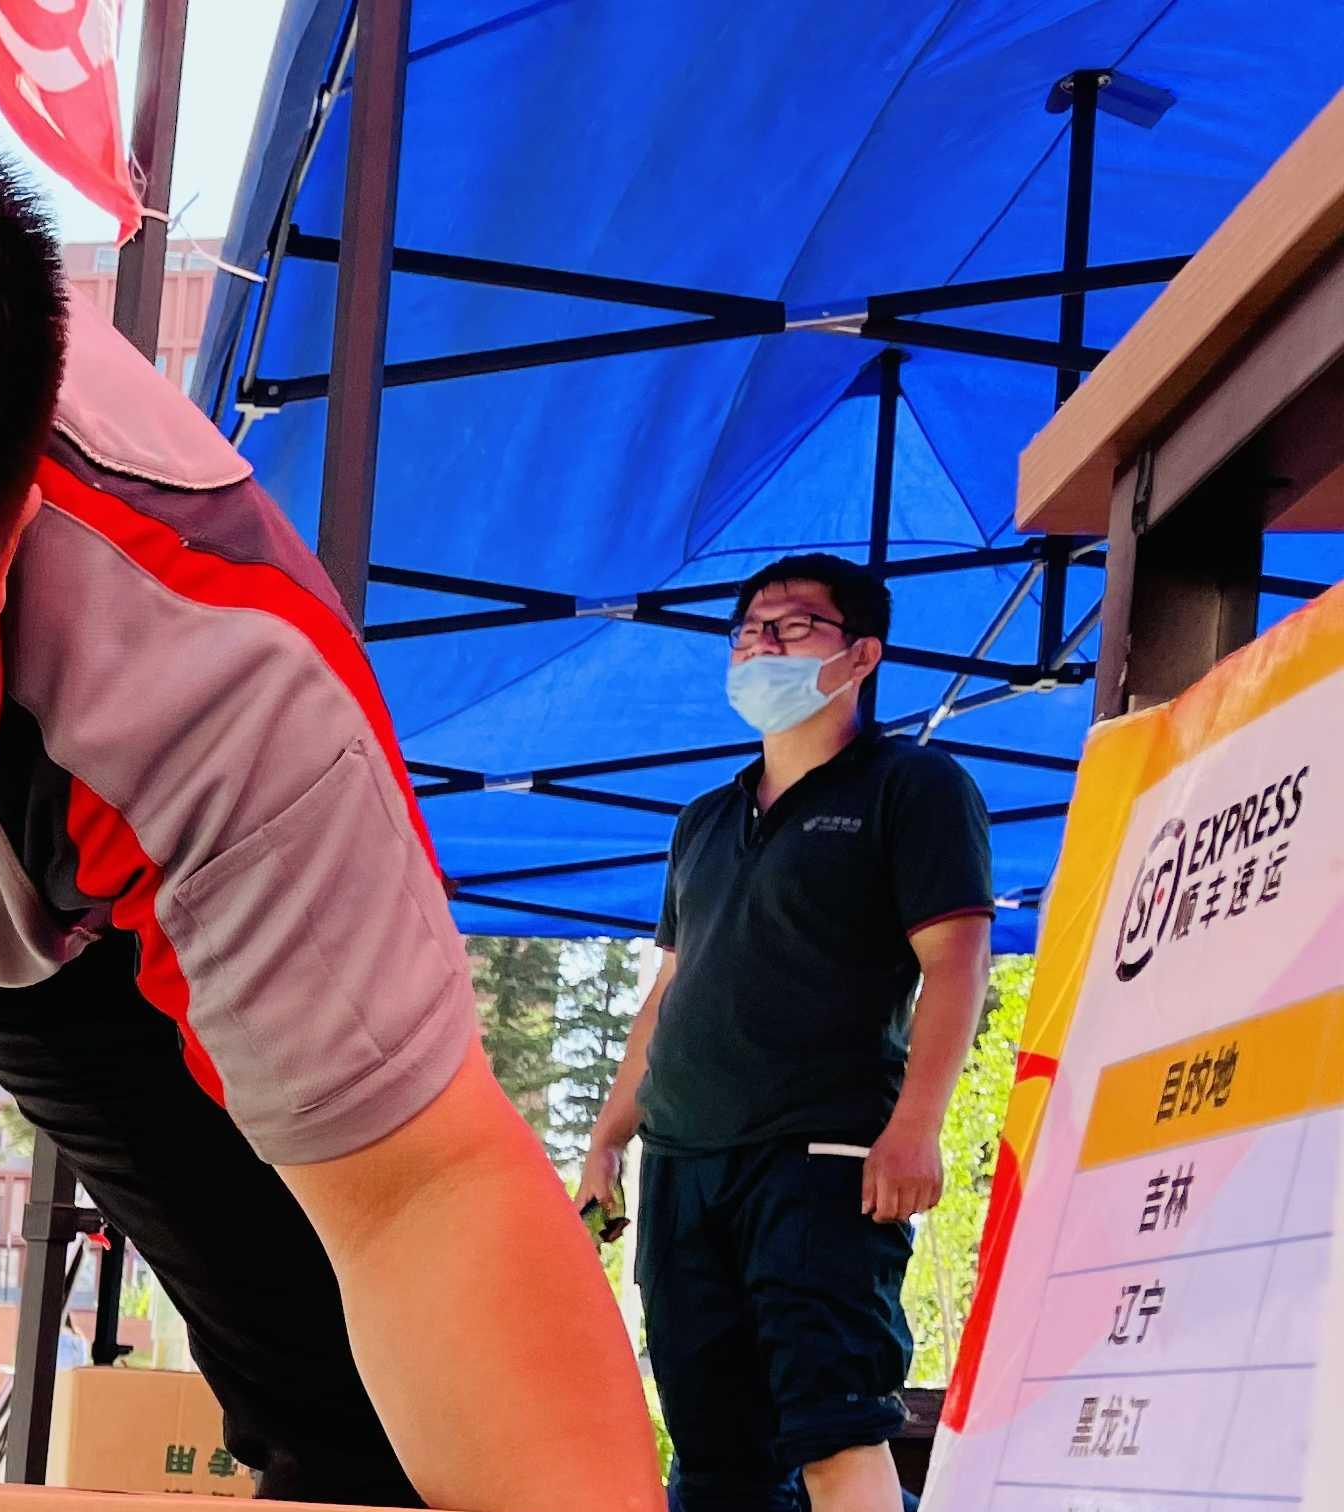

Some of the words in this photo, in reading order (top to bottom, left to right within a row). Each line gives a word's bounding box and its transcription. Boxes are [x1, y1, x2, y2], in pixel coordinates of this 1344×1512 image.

[1187, 765, 1310, 876] EXPRESS
[1171, 841, 1289, 943] 顺丰速运
[1155, 1041, 1240, 1125] 目的地
[1137, 1162, 1195, 1234] 吉林
[1105, 1279, 1166, 1344] 辽宁
[1068, 1395, 1150, 1457] 黑龙江
